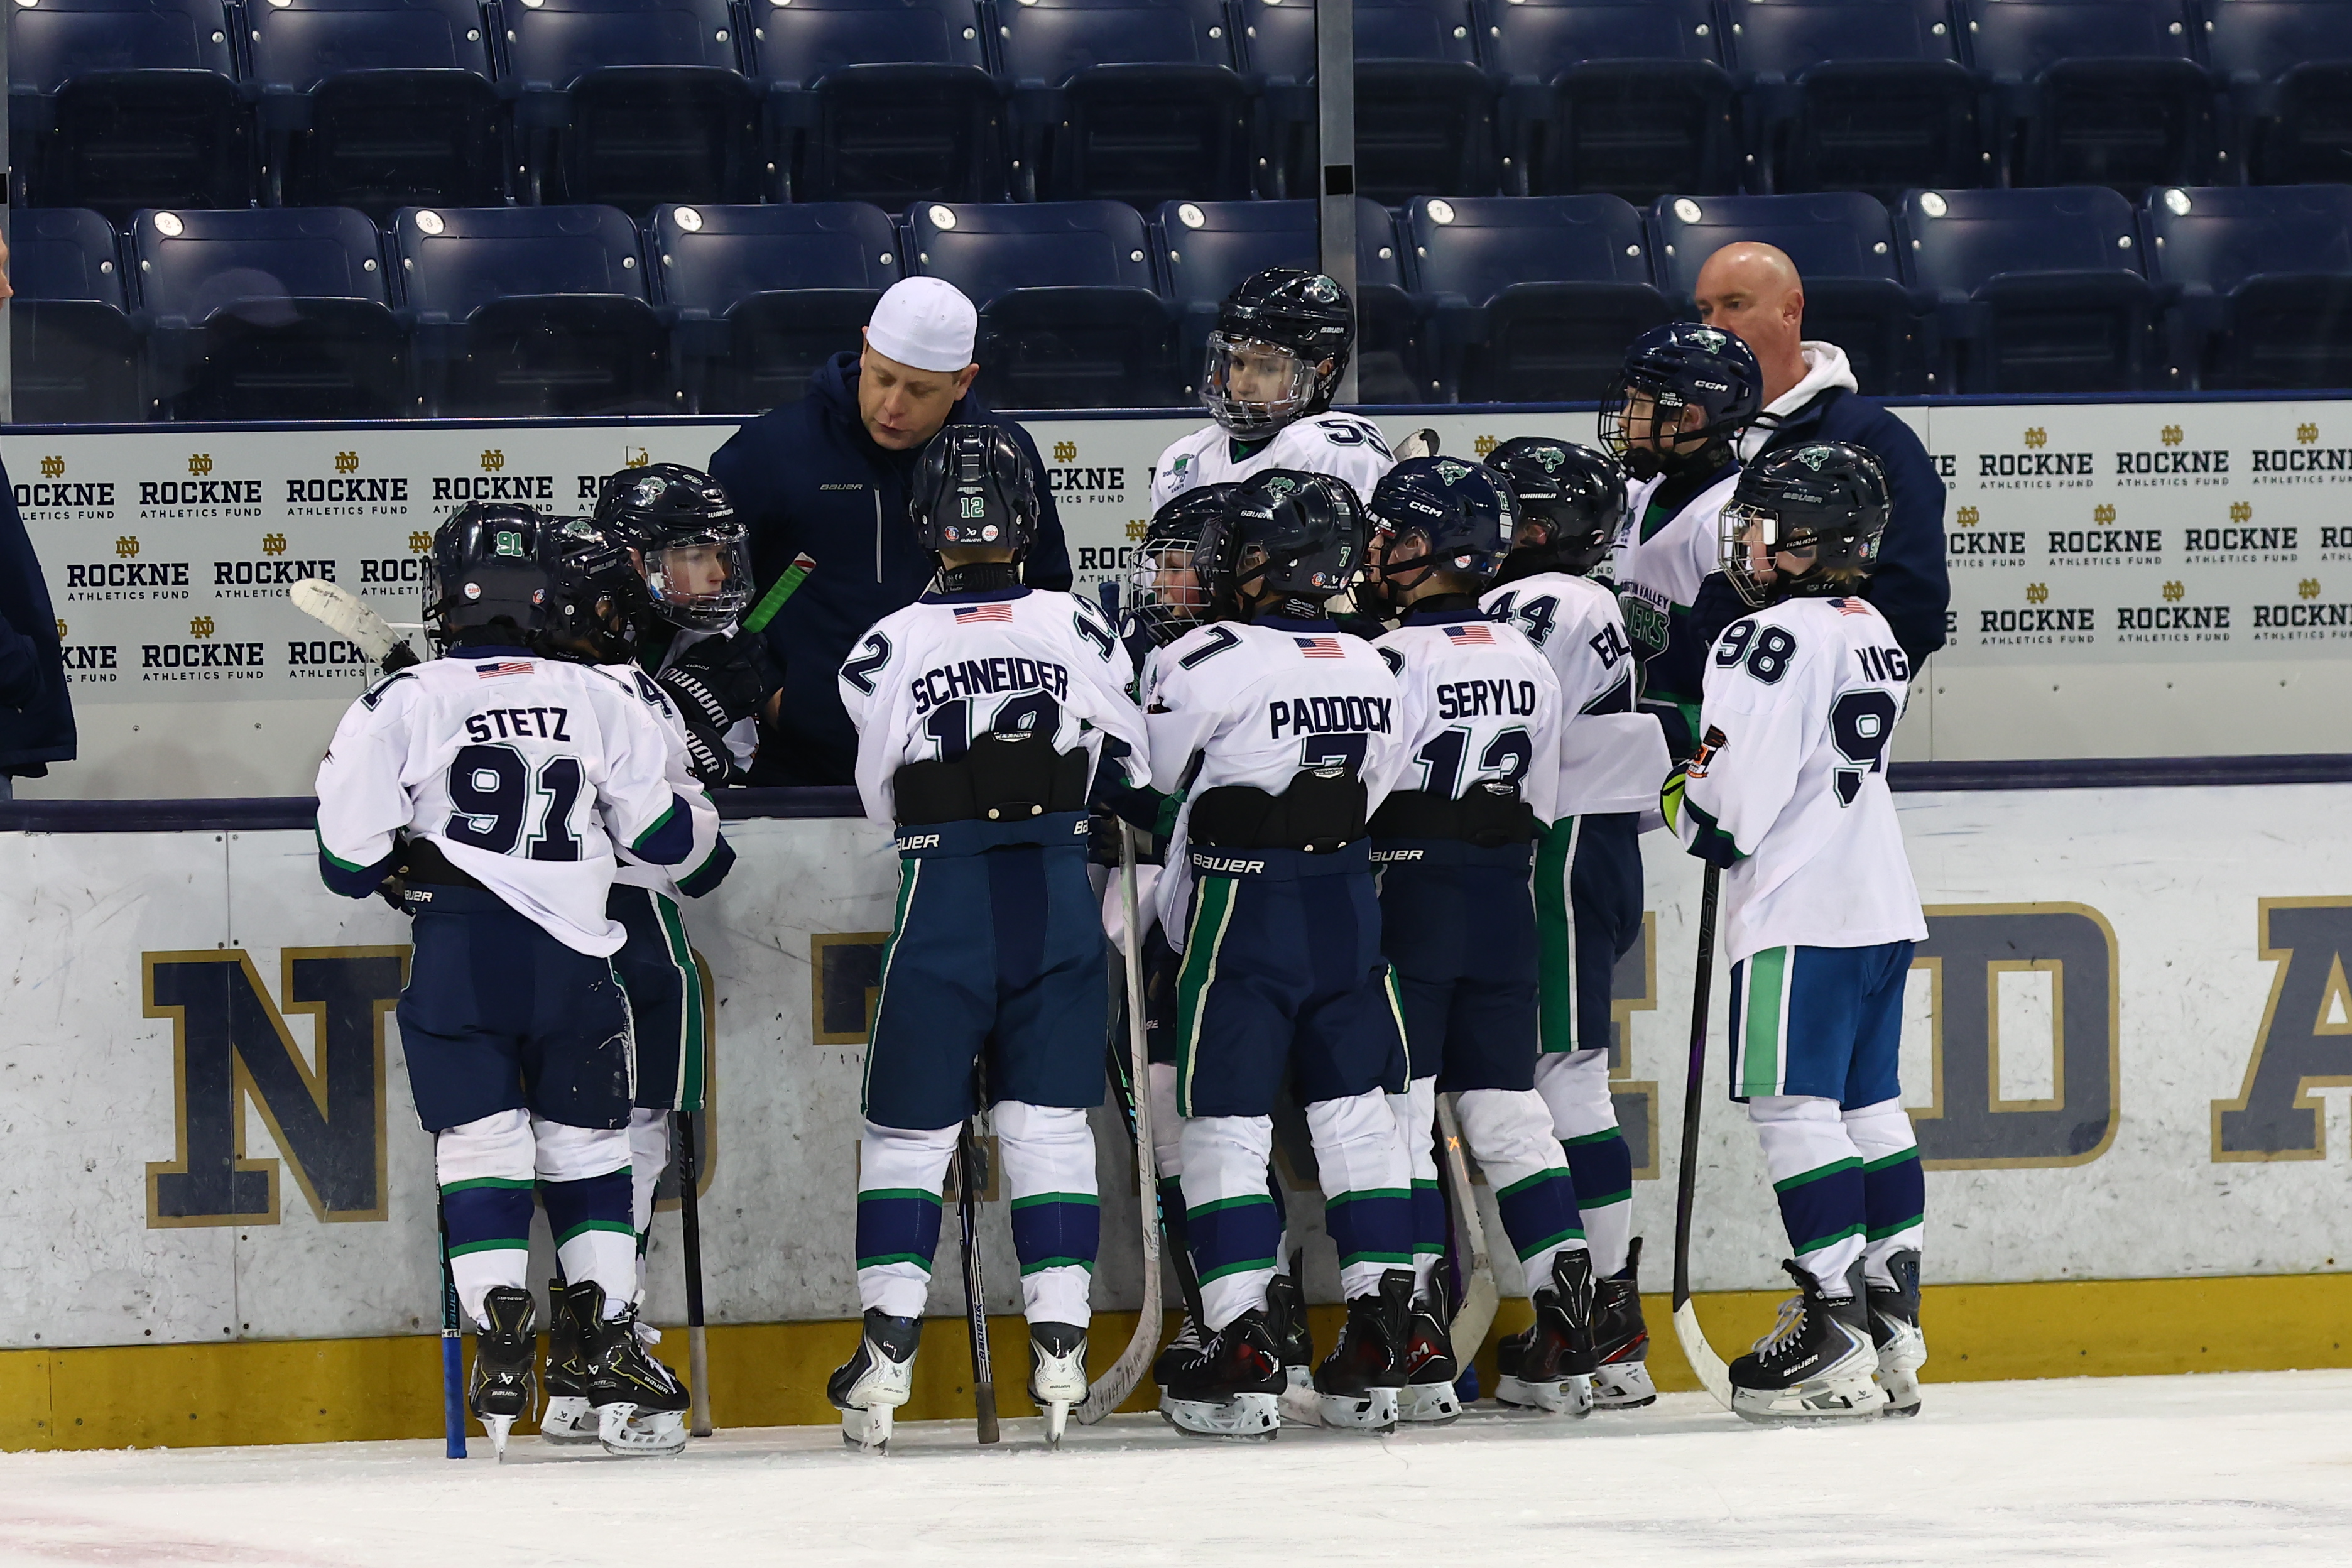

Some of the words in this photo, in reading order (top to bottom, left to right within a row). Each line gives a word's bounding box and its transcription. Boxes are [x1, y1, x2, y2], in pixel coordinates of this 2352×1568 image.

[1694, 379, 1728, 393] CCM
[1659, 399, 1684, 408] CCM
[1980, 453, 2093, 476] ROCKNE
[2116, 451, 2229, 474] ROCKNE
[2252, 449, 2352, 471] ROCKN
[433, 476, 553, 500] ROCKNE
[1048, 467, 1124, 490] CKNE
[1980, 480, 2052, 489] ATHLETICS
[2059, 479, 2093, 487] FUND
[2117, 478, 2188, 487] ATHLETICS
[2196, 477, 2229, 486] FUND
[2253, 475, 2323, 484] ATHLETICS
[14, 483, 114, 507] OCKNE
[139, 481, 262, 504] ROCKNE
[286, 478, 408, 502] ROCKNE
[1089, 494, 1124, 503] FUND
[22, 512, 70, 520] LETICS
[79, 511, 114, 520] FUND
[140, 509, 217, 518] ATHLETICS
[226, 508, 261, 517] FUND
[287, 506, 364, 516] ATHLETICS
[371, 506, 408, 514] FUND
[961, 496, 985, 518] 12
[1408, 501, 1444, 518] CCM
[496, 531, 523, 558] 91
[1951, 532, 2025, 554] CKNE
[2049, 530, 2162, 553] ROCKNE
[2186, 528, 2297, 550] ROCKNE
[1079, 547, 1133, 570] ROC
[1338, 546, 1351, 567] 7
[1947, 558, 1984, 567] ETICS
[1992, 558, 2025, 567] FUND
[2049, 557, 2121, 566] ATHLETICS
[2128, 557, 2162, 565] FUND
[2186, 554, 2257, 564] ATHLETICS
[2264, 553, 2297, 562] FUND
[67, 562, 189, 587] ROCKNE
[214, 560, 335, 585] ROCKNE
[360, 559, 425, 582] ROC
[1589, 566, 1613, 575] UND
[68, 592, 144, 601] ATHLETICS
[153, 591, 189, 599] FUND
[361, 587, 419, 596] ATHLETI
[1486, 589, 1561, 648] 44
[1981, 609, 2094, 632] ROCKNE
[2117, 606, 2230, 629] ROCKNE
[2253, 604, 2352, 628] ROCKN
[1981, 635, 2053, 645] ATHLETICS
[2061, 635, 2094, 643] FUND
[2118, 633, 2189, 642] ATHLETICS
[2196, 633, 2230, 641] FUND
[2254, 631, 2324, 641] ATHLETICS
[61, 645, 117, 669] KNE
[142, 642, 264, 668] ROCKNE
[1178, 624, 1244, 671] 7
[1716, 618, 1799, 686] 98
[80, 673, 117, 682] FUND
[143, 672, 220, 681] ATHLETICS
[227, 670, 263, 680] FUND
[290, 668, 365, 678] ATHLETICS
[912, 656, 1069, 716] SCHNEIDER
[1436, 678, 1537, 721] SERYLO
[466, 707, 570, 743] STETZ
[1269, 695, 1393, 739] PADDOCK
[443, 743, 585, 861] 91
[896, 834, 940, 851] AUER
[1192, 852, 1265, 874] BAUER
[1370, 847, 1424, 861] AUER
[404, 890, 433, 903] AUER
[1783, 1353, 1820, 1377] BAUER
[643, 1375, 670, 1395] BAUER
